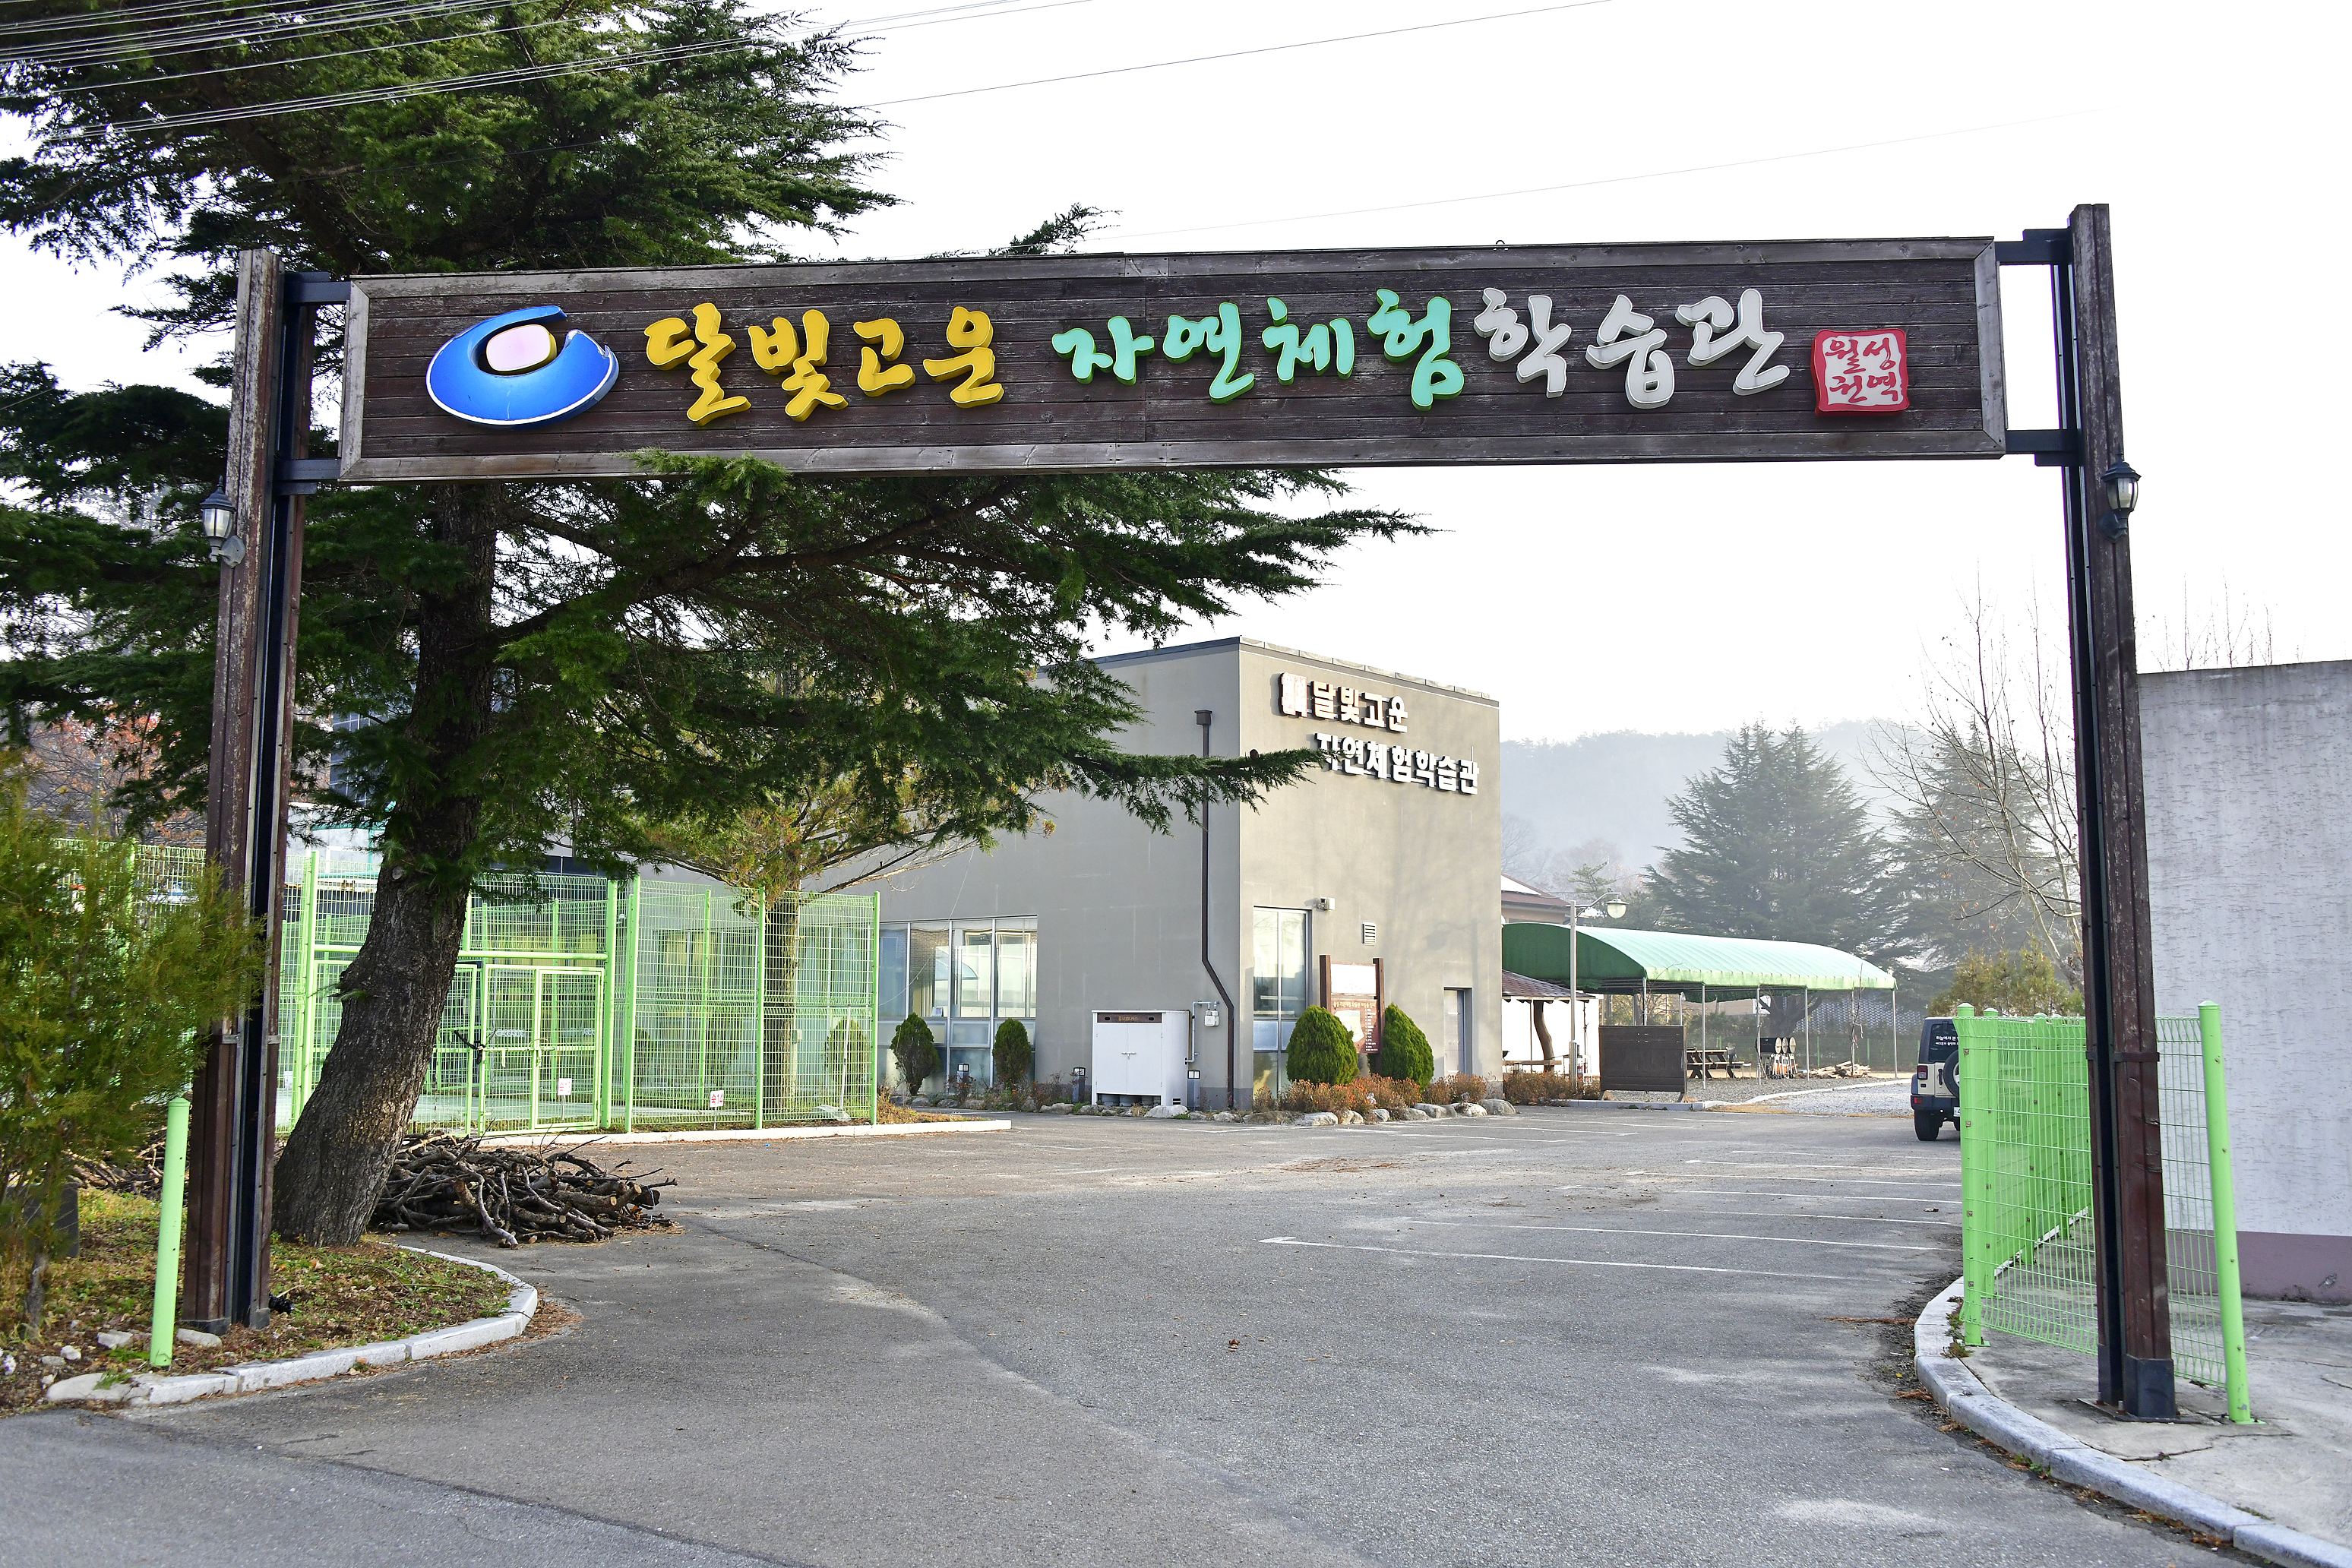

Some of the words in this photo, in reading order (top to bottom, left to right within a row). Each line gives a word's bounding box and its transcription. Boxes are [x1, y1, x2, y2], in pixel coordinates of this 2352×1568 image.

[643, 302, 1004, 426] 달빛고운
[1825, 337, 1896, 375] 월성
[1310, 680, 1409, 733] 달빛고운
[1314, 732, 1480, 795] 자연체험학습관
